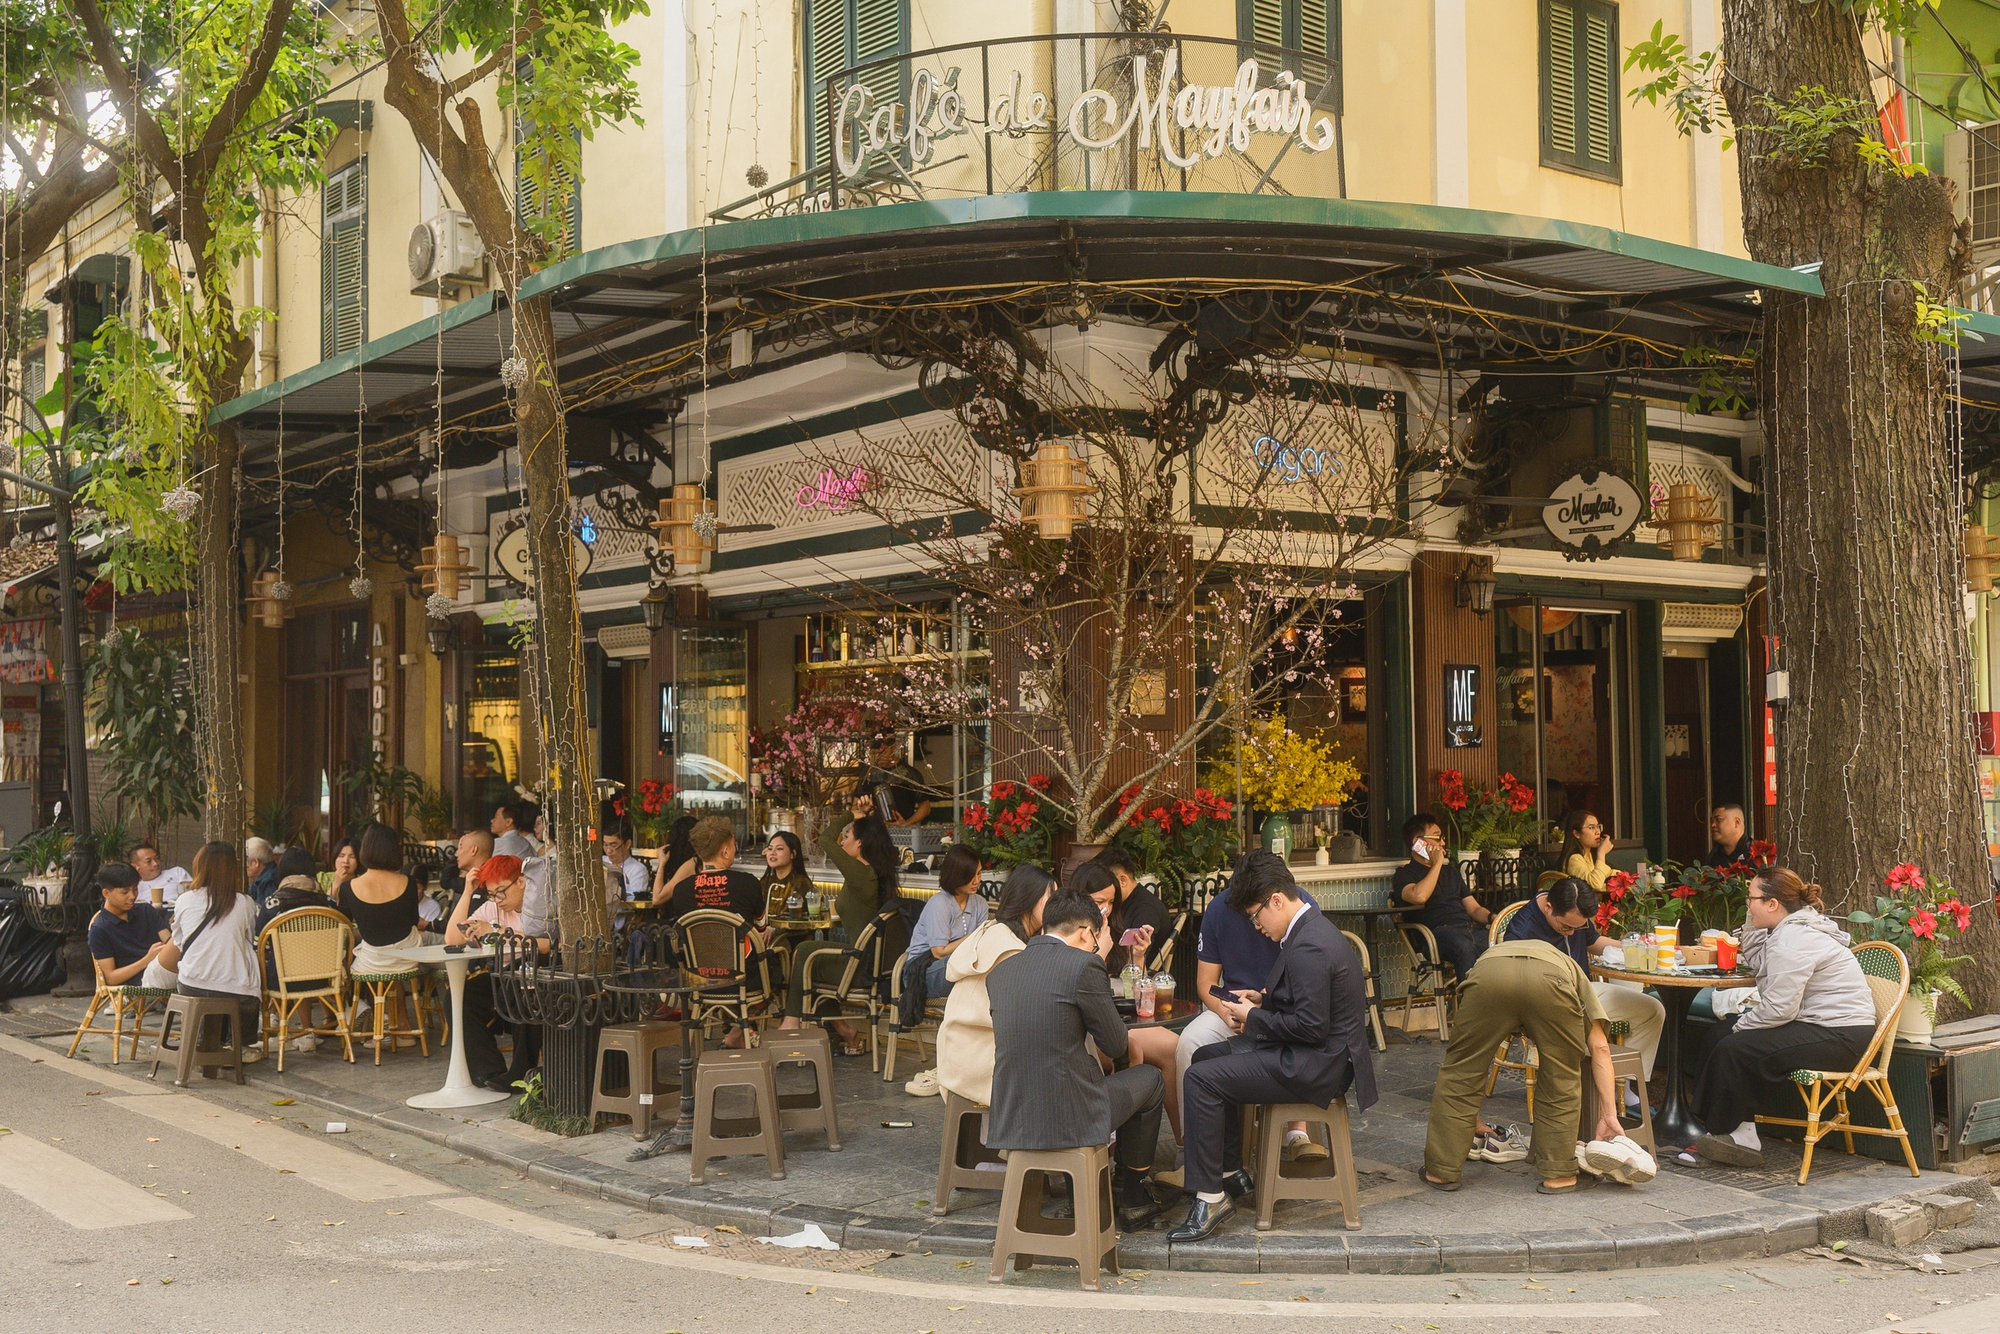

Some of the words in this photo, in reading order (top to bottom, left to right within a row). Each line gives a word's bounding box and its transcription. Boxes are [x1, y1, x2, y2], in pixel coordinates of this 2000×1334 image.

[835, 66, 968, 178] Café
[984, 69, 1049, 133] de
[1068, 48, 1334, 169] Mayfair
[1255, 436, 1343, 482] Cigars
[1558, 493, 1623, 525] Mayfair
[1453, 669, 1475, 722] MF
[694, 873, 728, 890] Bape
